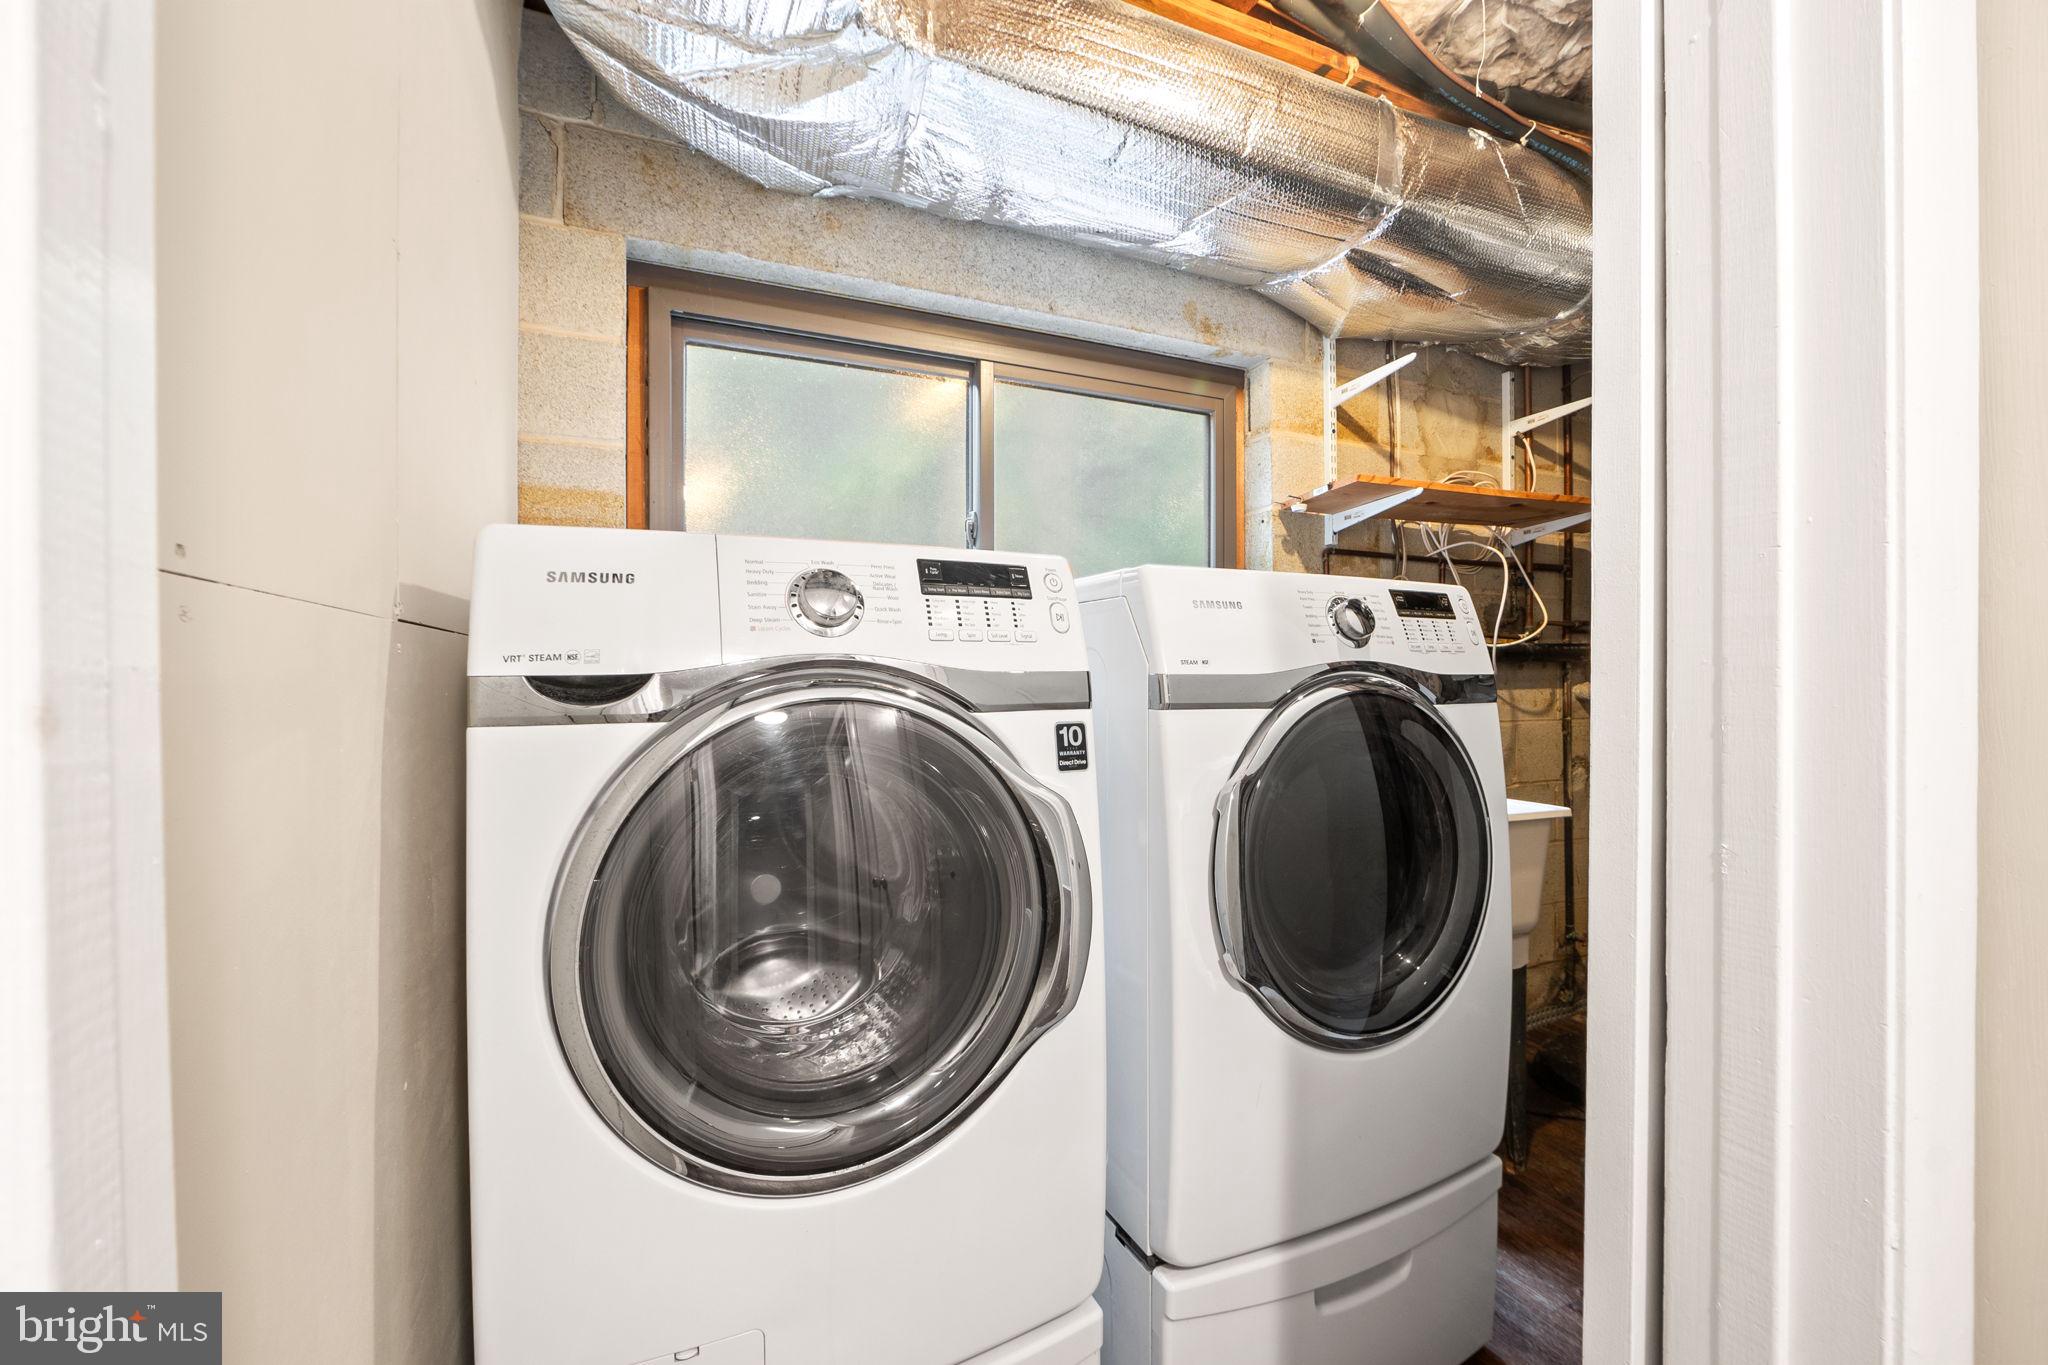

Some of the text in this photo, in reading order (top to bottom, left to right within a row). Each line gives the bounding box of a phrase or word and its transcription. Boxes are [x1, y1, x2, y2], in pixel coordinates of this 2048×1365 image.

[546, 571, 635, 584] SAMSUNG
[1192, 600, 1243, 610] SAMSUNG
[528, 653, 562, 662] STEAM
[1059, 725, 1083, 747] 10
